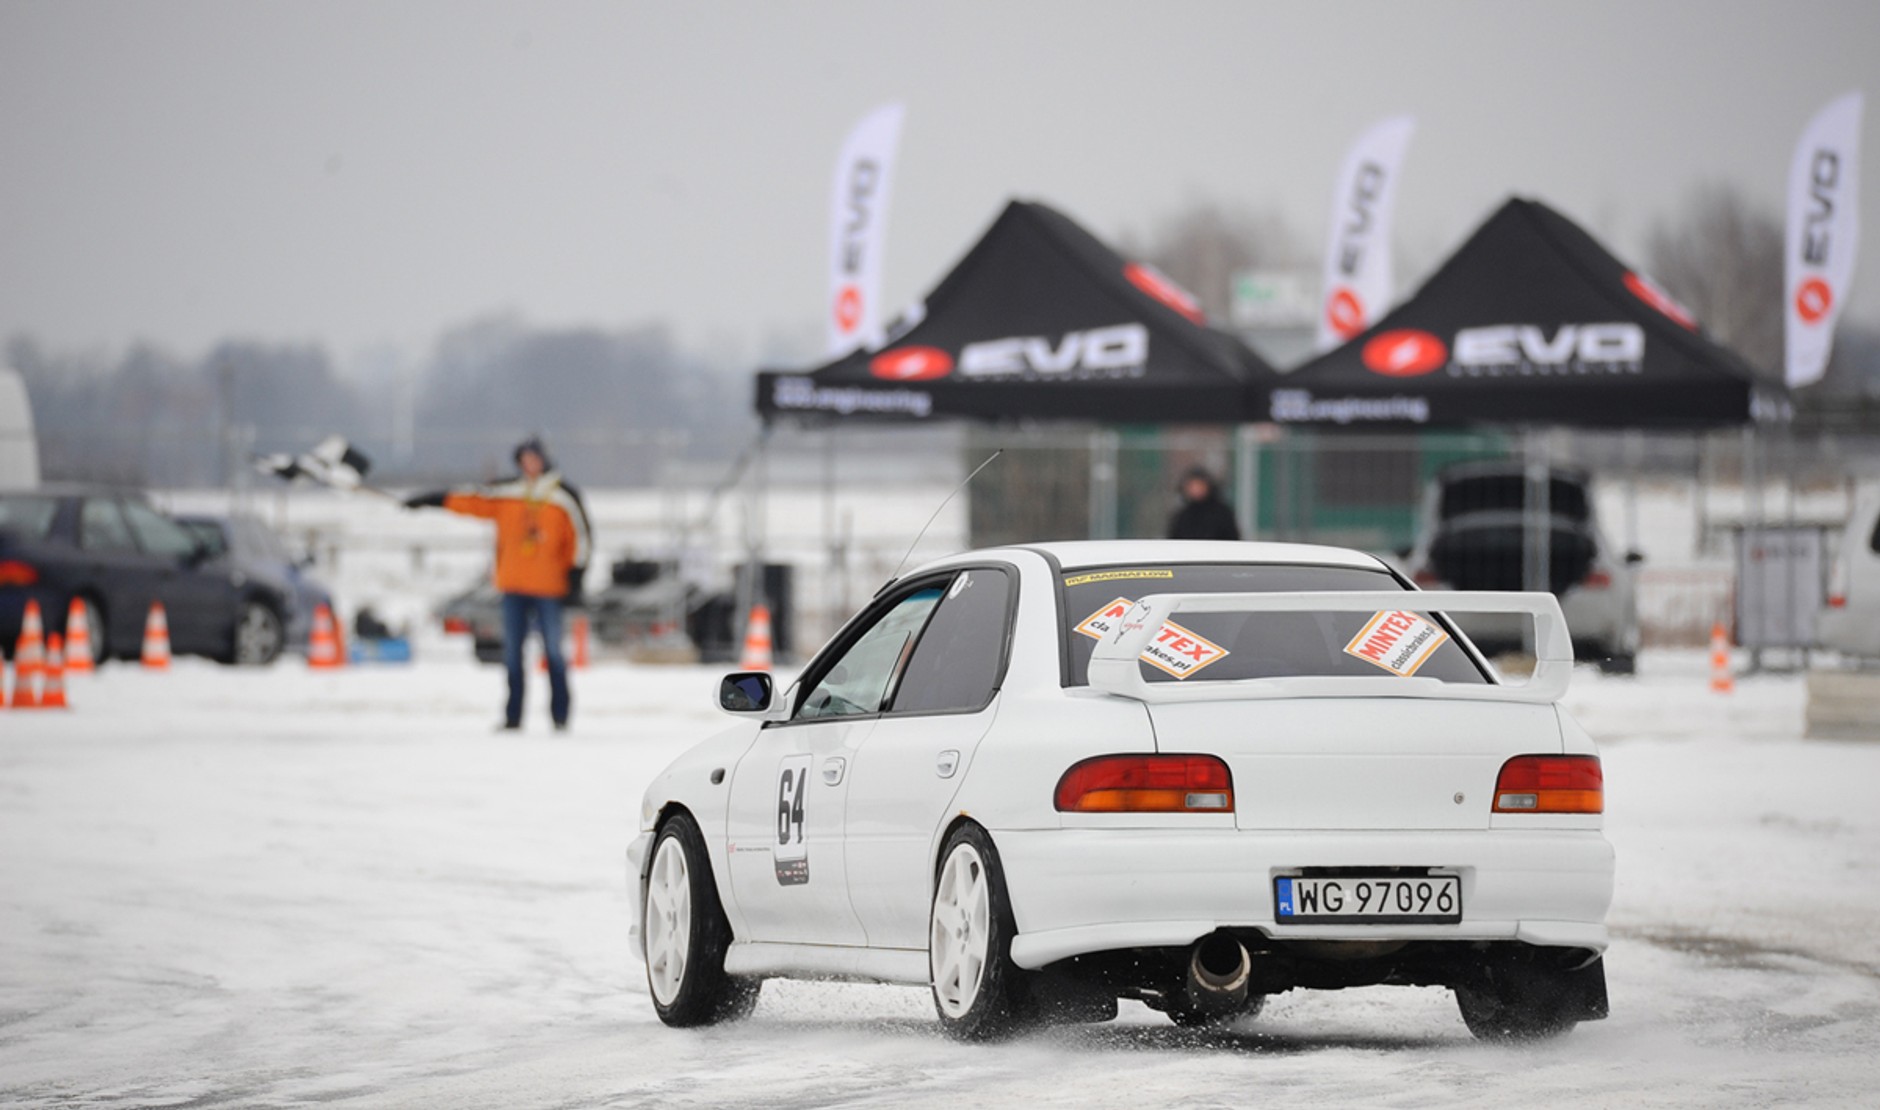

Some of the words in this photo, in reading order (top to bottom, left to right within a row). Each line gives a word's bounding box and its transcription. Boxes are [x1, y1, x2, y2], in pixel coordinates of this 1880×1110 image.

[843, 157, 879, 274] EVO
[1340, 160, 1385, 275] EVO
[1803, 149, 1840, 266] EVO
[958, 322, 1149, 375] EVO
[1453, 322, 1646, 366] EVO
[1358, 611, 1418, 661] MINTEX
[778, 767, 807, 845] 64
[1280, 902, 1291, 911] PL
[1298, 882, 1343, 913] WG
[1356, 882, 1453, 913] 97096
